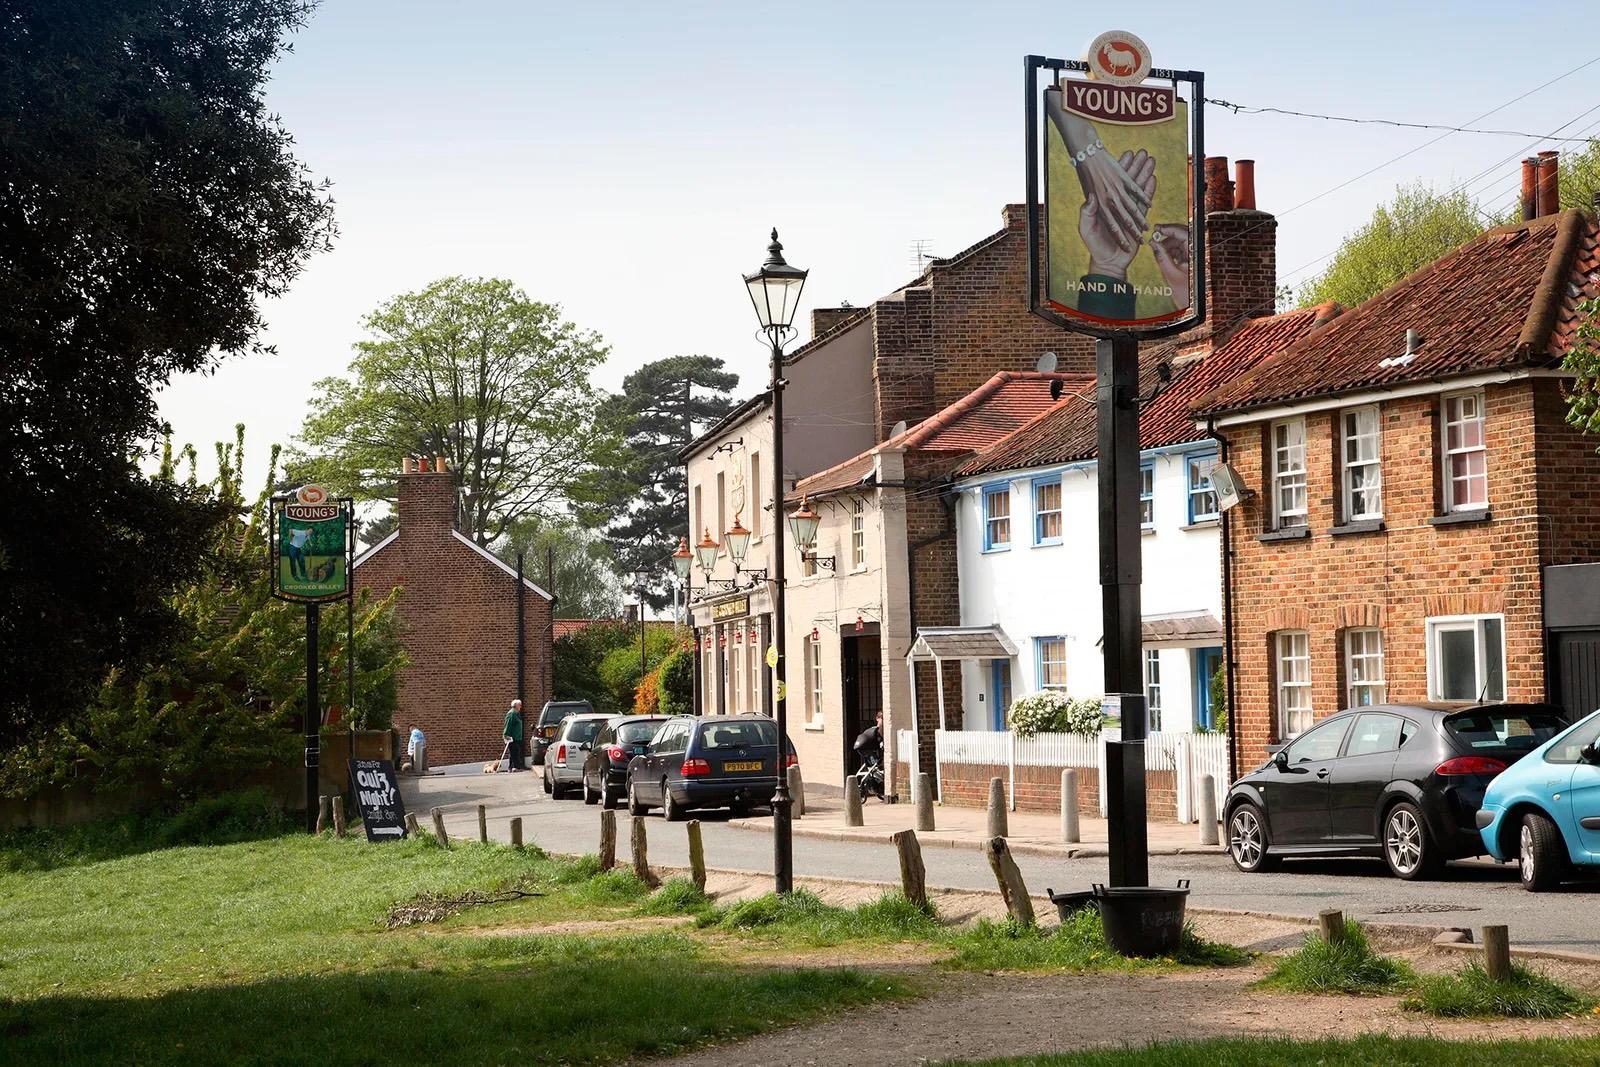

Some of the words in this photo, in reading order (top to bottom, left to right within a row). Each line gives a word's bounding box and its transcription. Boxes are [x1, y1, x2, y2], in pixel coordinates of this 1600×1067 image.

[1155, 68, 1175, 79] 1831
[1073, 86, 1168, 115] YOUNG'S
[1066, 280, 1107, 293] HAND
[1113, 283, 1127, 294] IN
[1133, 285, 1173, 297] HAND
[290, 507, 335, 518] YOUNG'S
